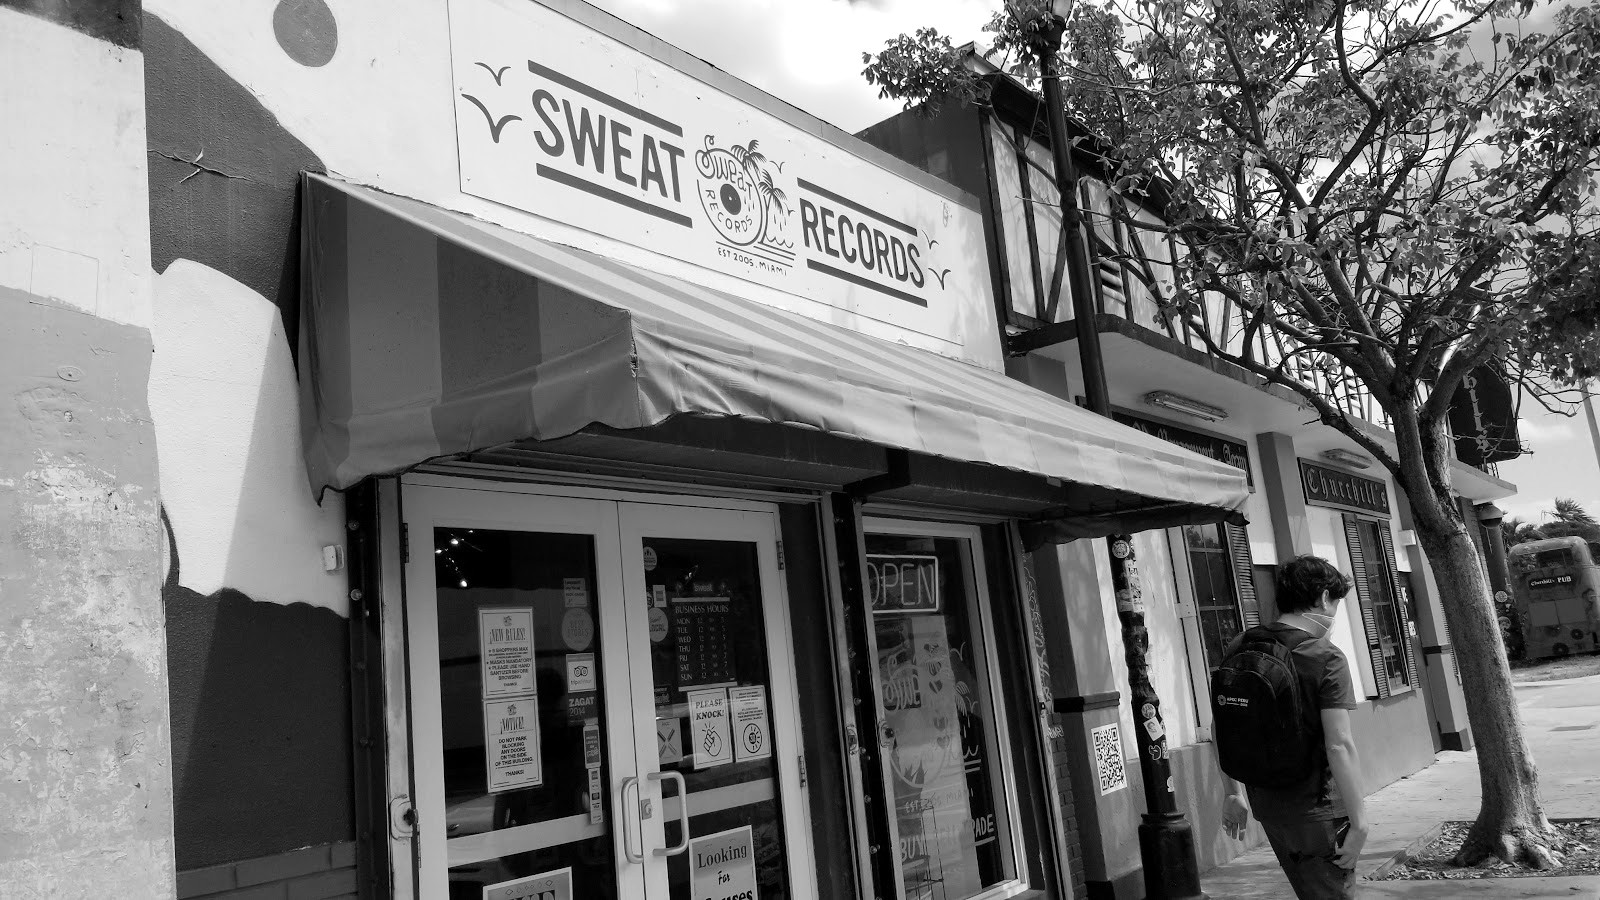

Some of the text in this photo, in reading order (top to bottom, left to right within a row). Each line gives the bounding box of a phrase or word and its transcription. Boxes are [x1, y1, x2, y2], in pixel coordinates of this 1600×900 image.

[532, 88, 685, 203] SWEAT
[705, 189, 752, 233] RECORDS
[800, 197, 925, 289] RECORDS
[718, 247, 731, 258] EST
[759, 261, 787, 276] MIAMI
[1307, 468, 1388, 509] Churchill's
[1557, 575, 1572, 583] PUB
[675, 604, 730, 614] BUSINESS HOURS
[680, 664, 690, 672] SAT
[568, 696, 595, 708] ZAGAT
[695, 698, 723, 709] PLEASE
[569, 707, 586, 716] 2014
[695, 709, 725, 721] KNOCK!
[501, 741, 525, 749] BLOCKING
[697, 845, 748, 869] Looking
